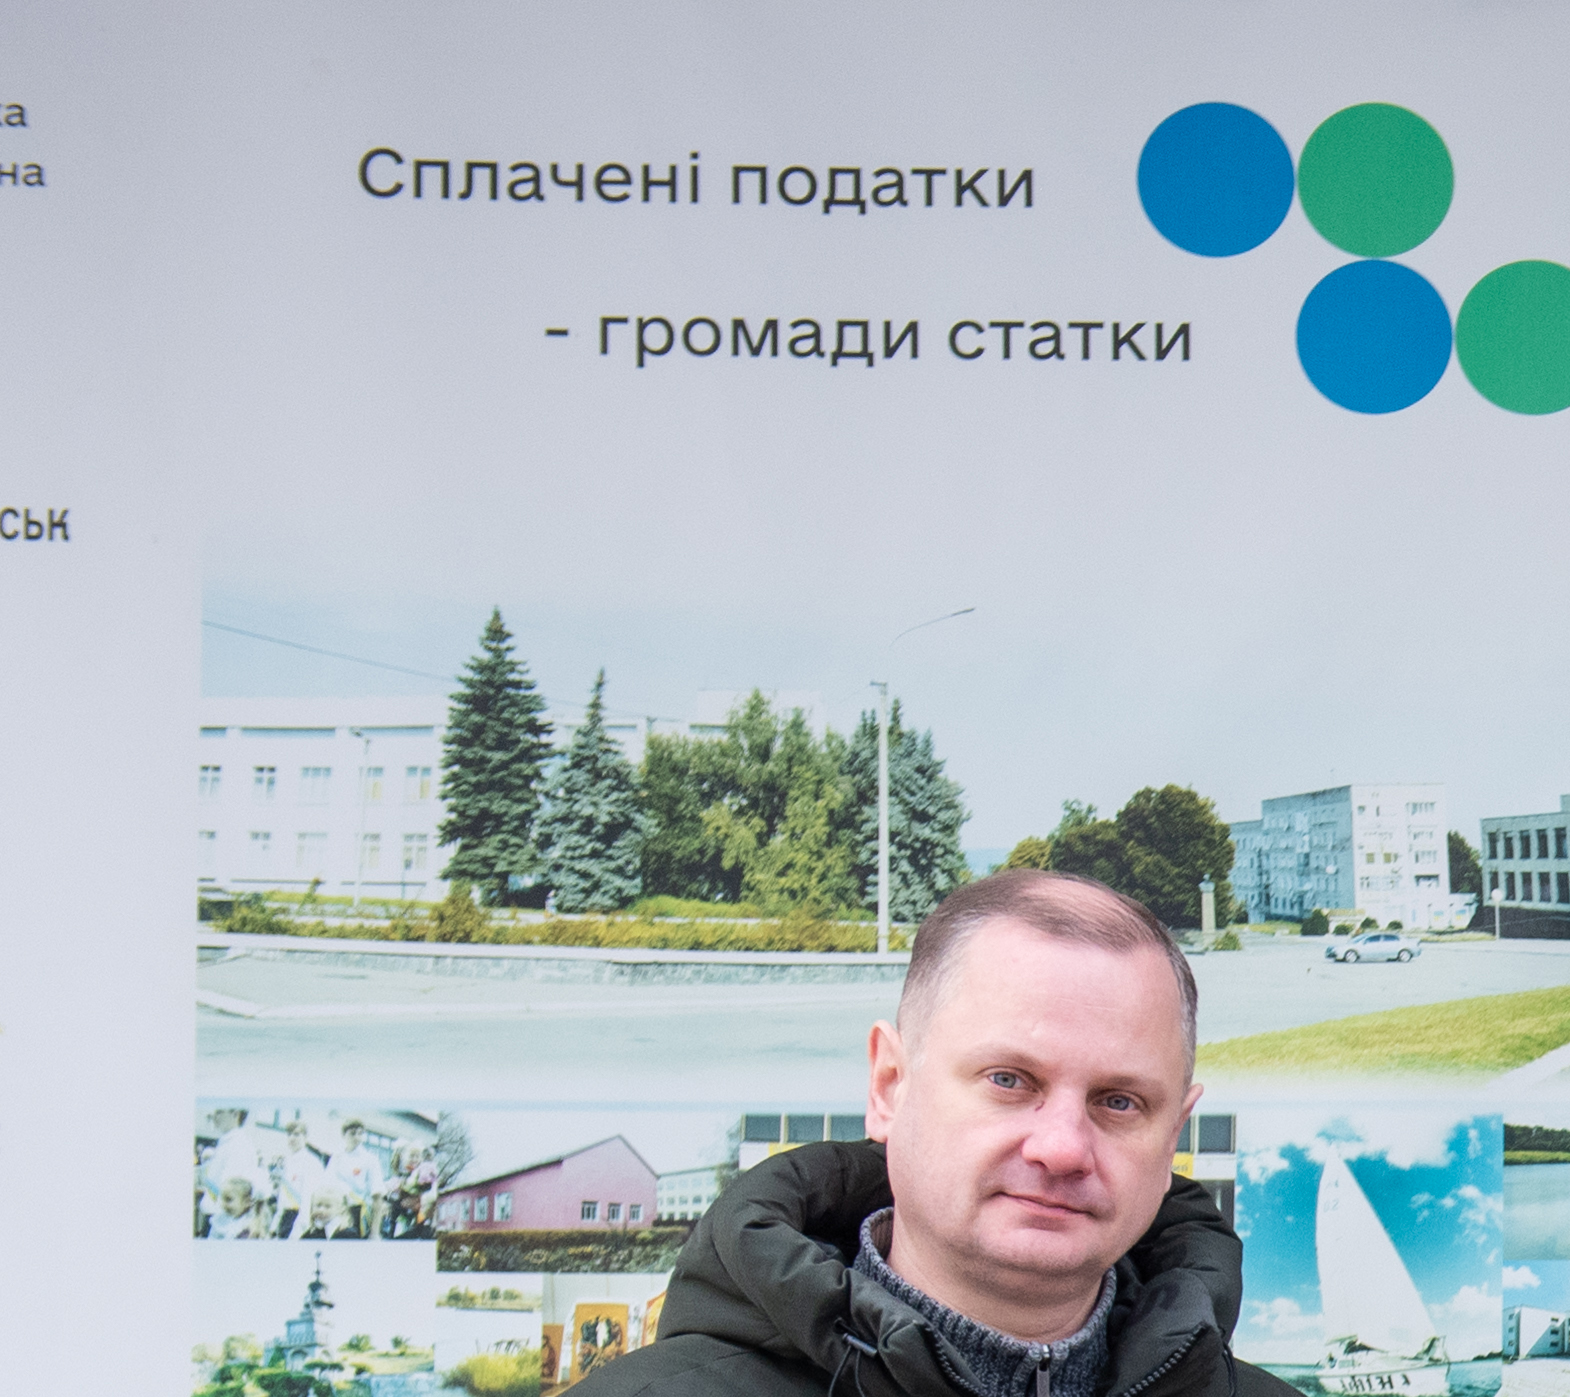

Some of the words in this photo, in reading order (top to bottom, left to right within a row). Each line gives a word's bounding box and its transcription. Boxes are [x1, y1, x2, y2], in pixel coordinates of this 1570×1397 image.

[359, 148, 699, 203] Сплачені
[733, 166, 1033, 215] податки
[601, 317, 918, 368] громади
[949, 321, 1190, 361] статки
